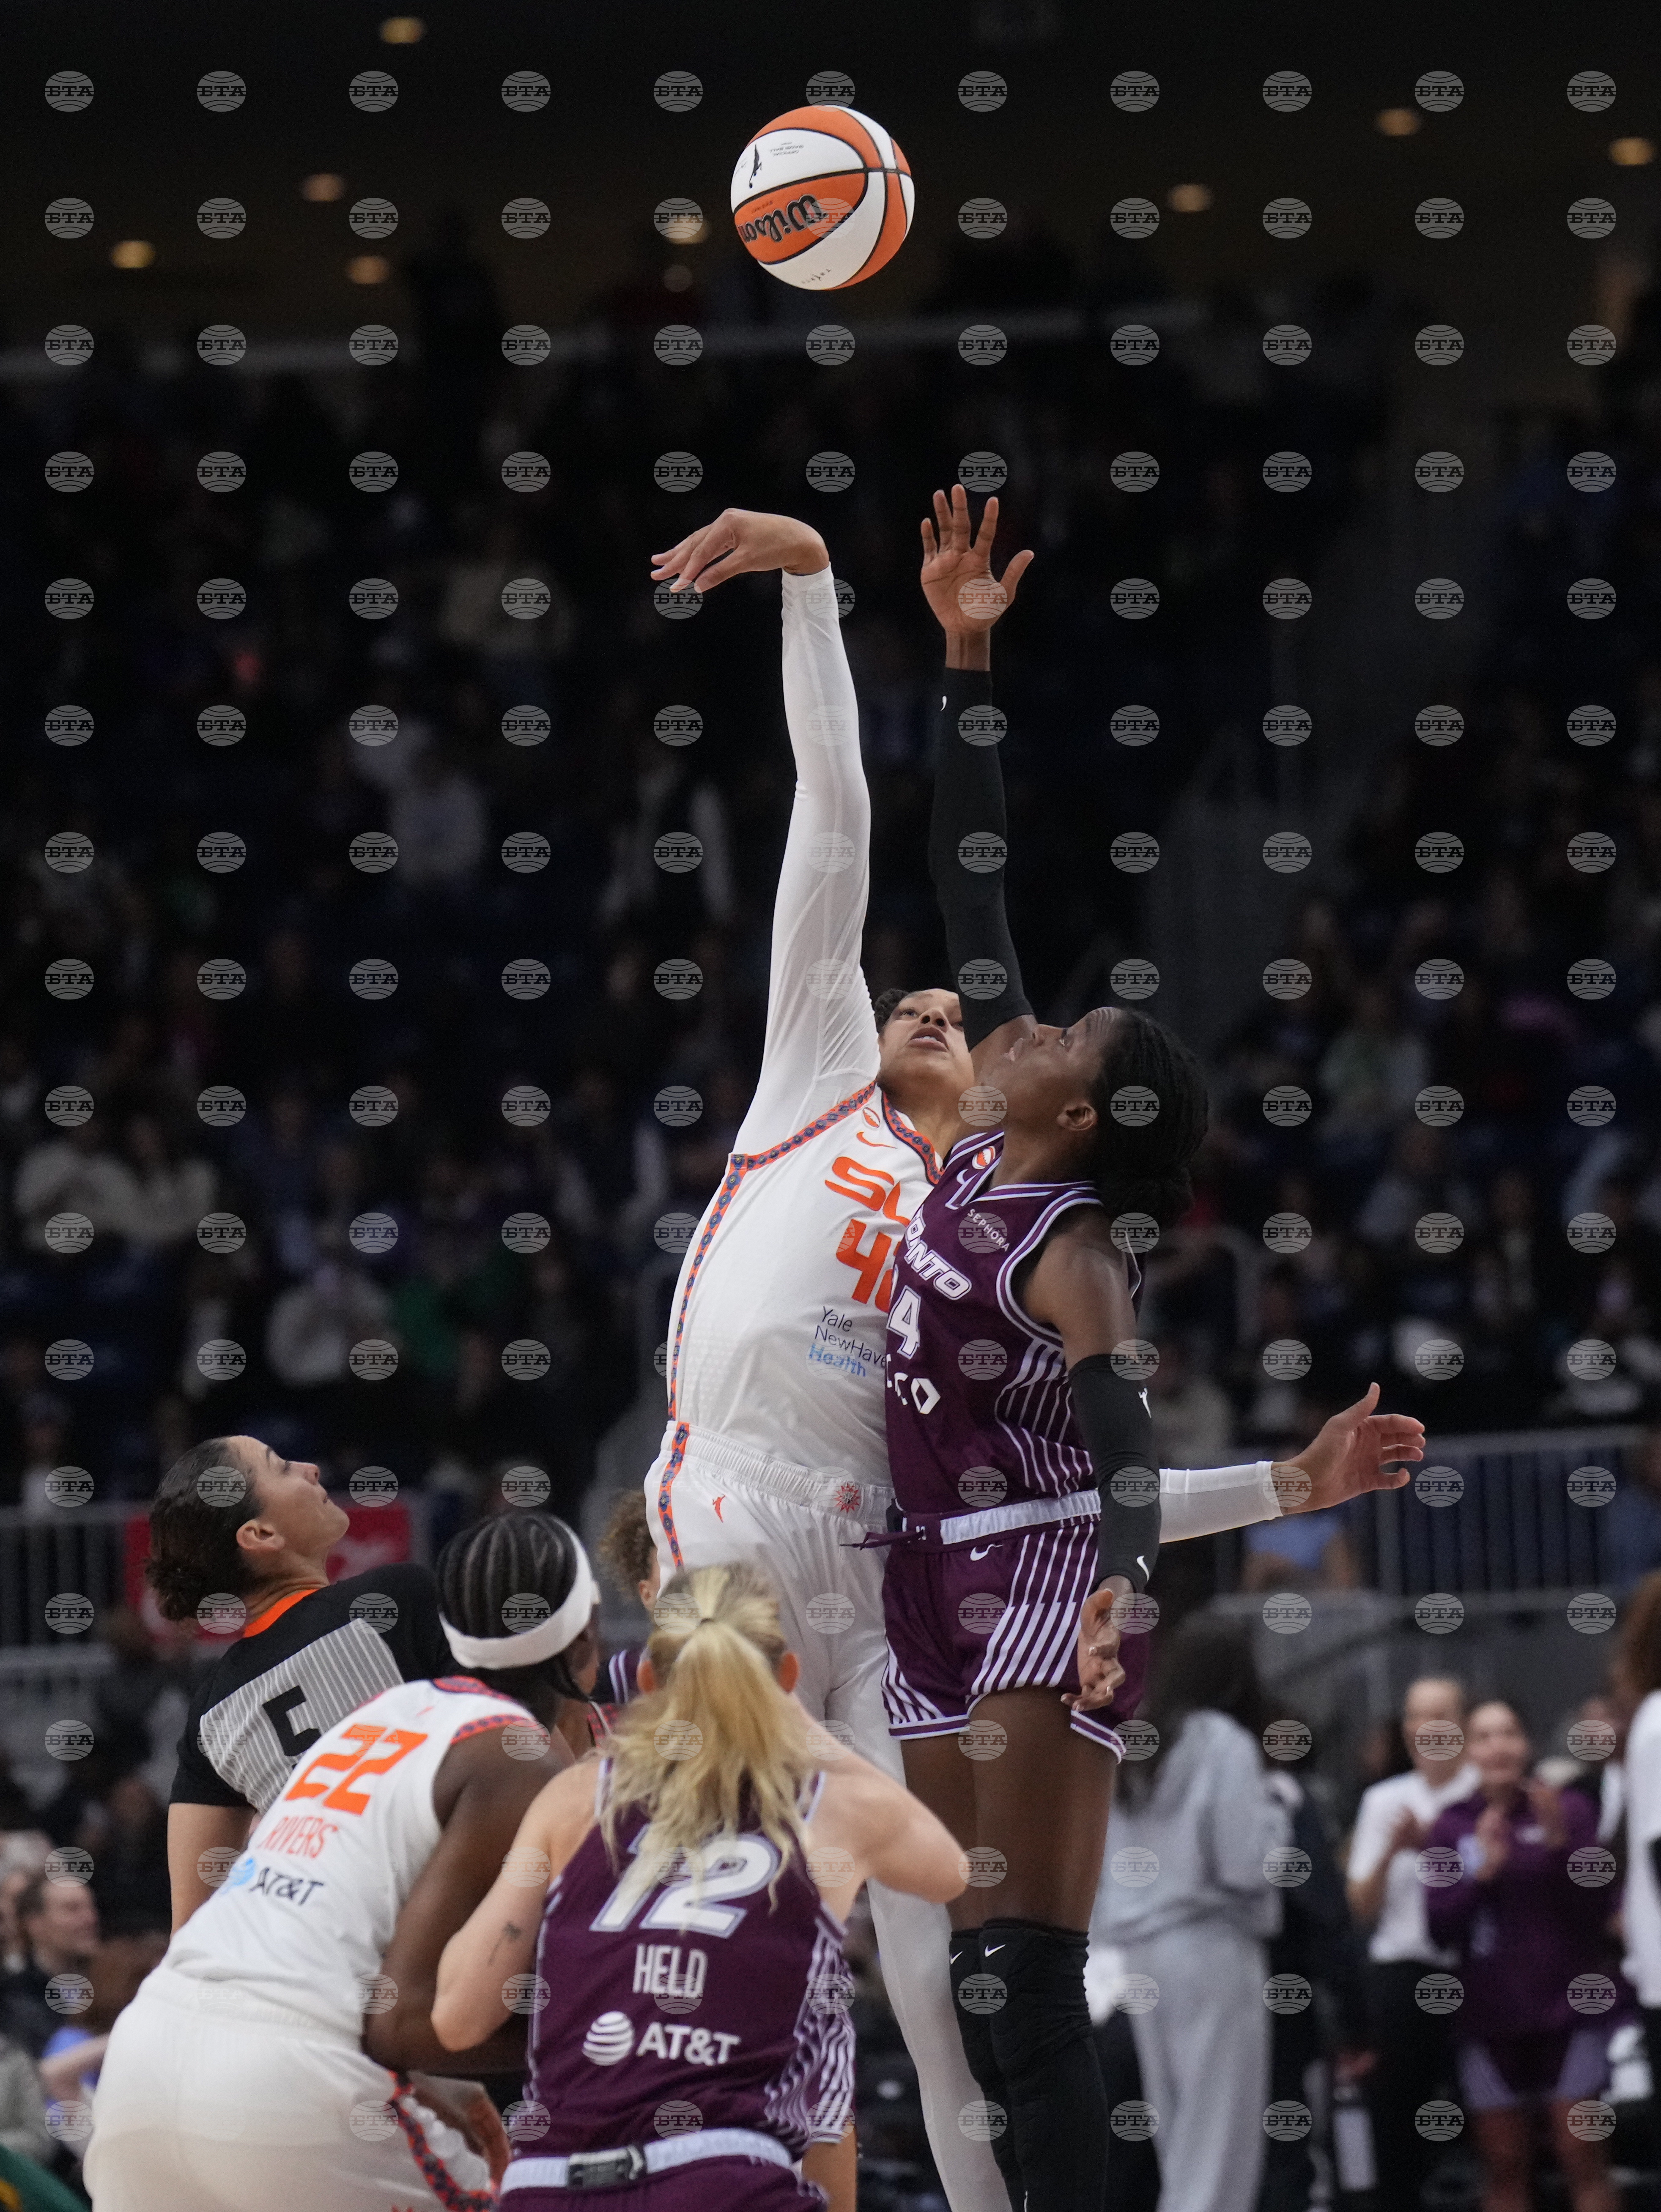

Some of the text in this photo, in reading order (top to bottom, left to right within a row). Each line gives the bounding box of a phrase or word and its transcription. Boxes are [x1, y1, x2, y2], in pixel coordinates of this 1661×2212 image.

[737, 194, 828, 244] Wilson
[967, 1208, 1010, 1252] SEPHORA
[821, 1306, 852, 1332] Yale
[809, 1343, 866, 1378] Health
[284, 1723, 429, 1815] 22
[256, 1816, 338, 1859] RIVERS
[249, 1866, 325, 1906] AT&T
[589, 1823, 781, 1939] 12
[633, 1943, 708, 1999] HELD
[636, 2021, 742, 2067] AT&T
